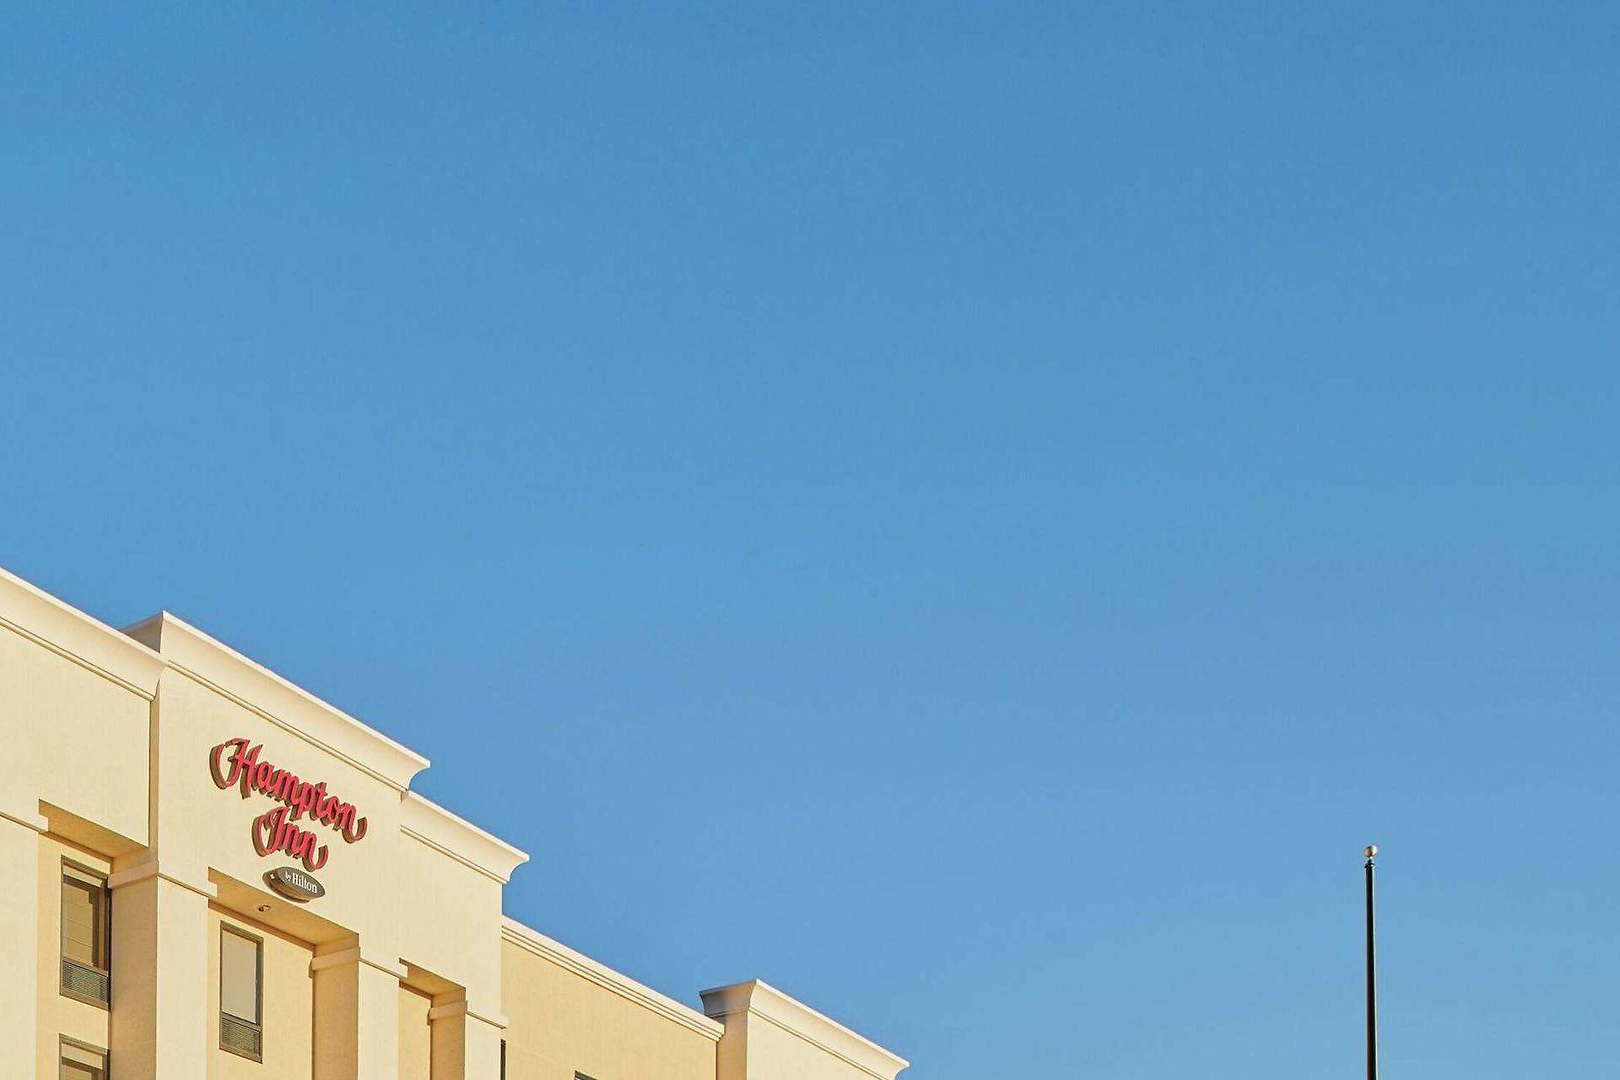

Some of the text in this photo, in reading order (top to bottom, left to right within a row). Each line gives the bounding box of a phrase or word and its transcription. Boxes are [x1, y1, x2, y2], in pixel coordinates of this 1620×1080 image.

[209, 738, 367, 844] Hampton
[252, 806, 329, 872] Inn
[292, 872, 318, 894] Hilton
